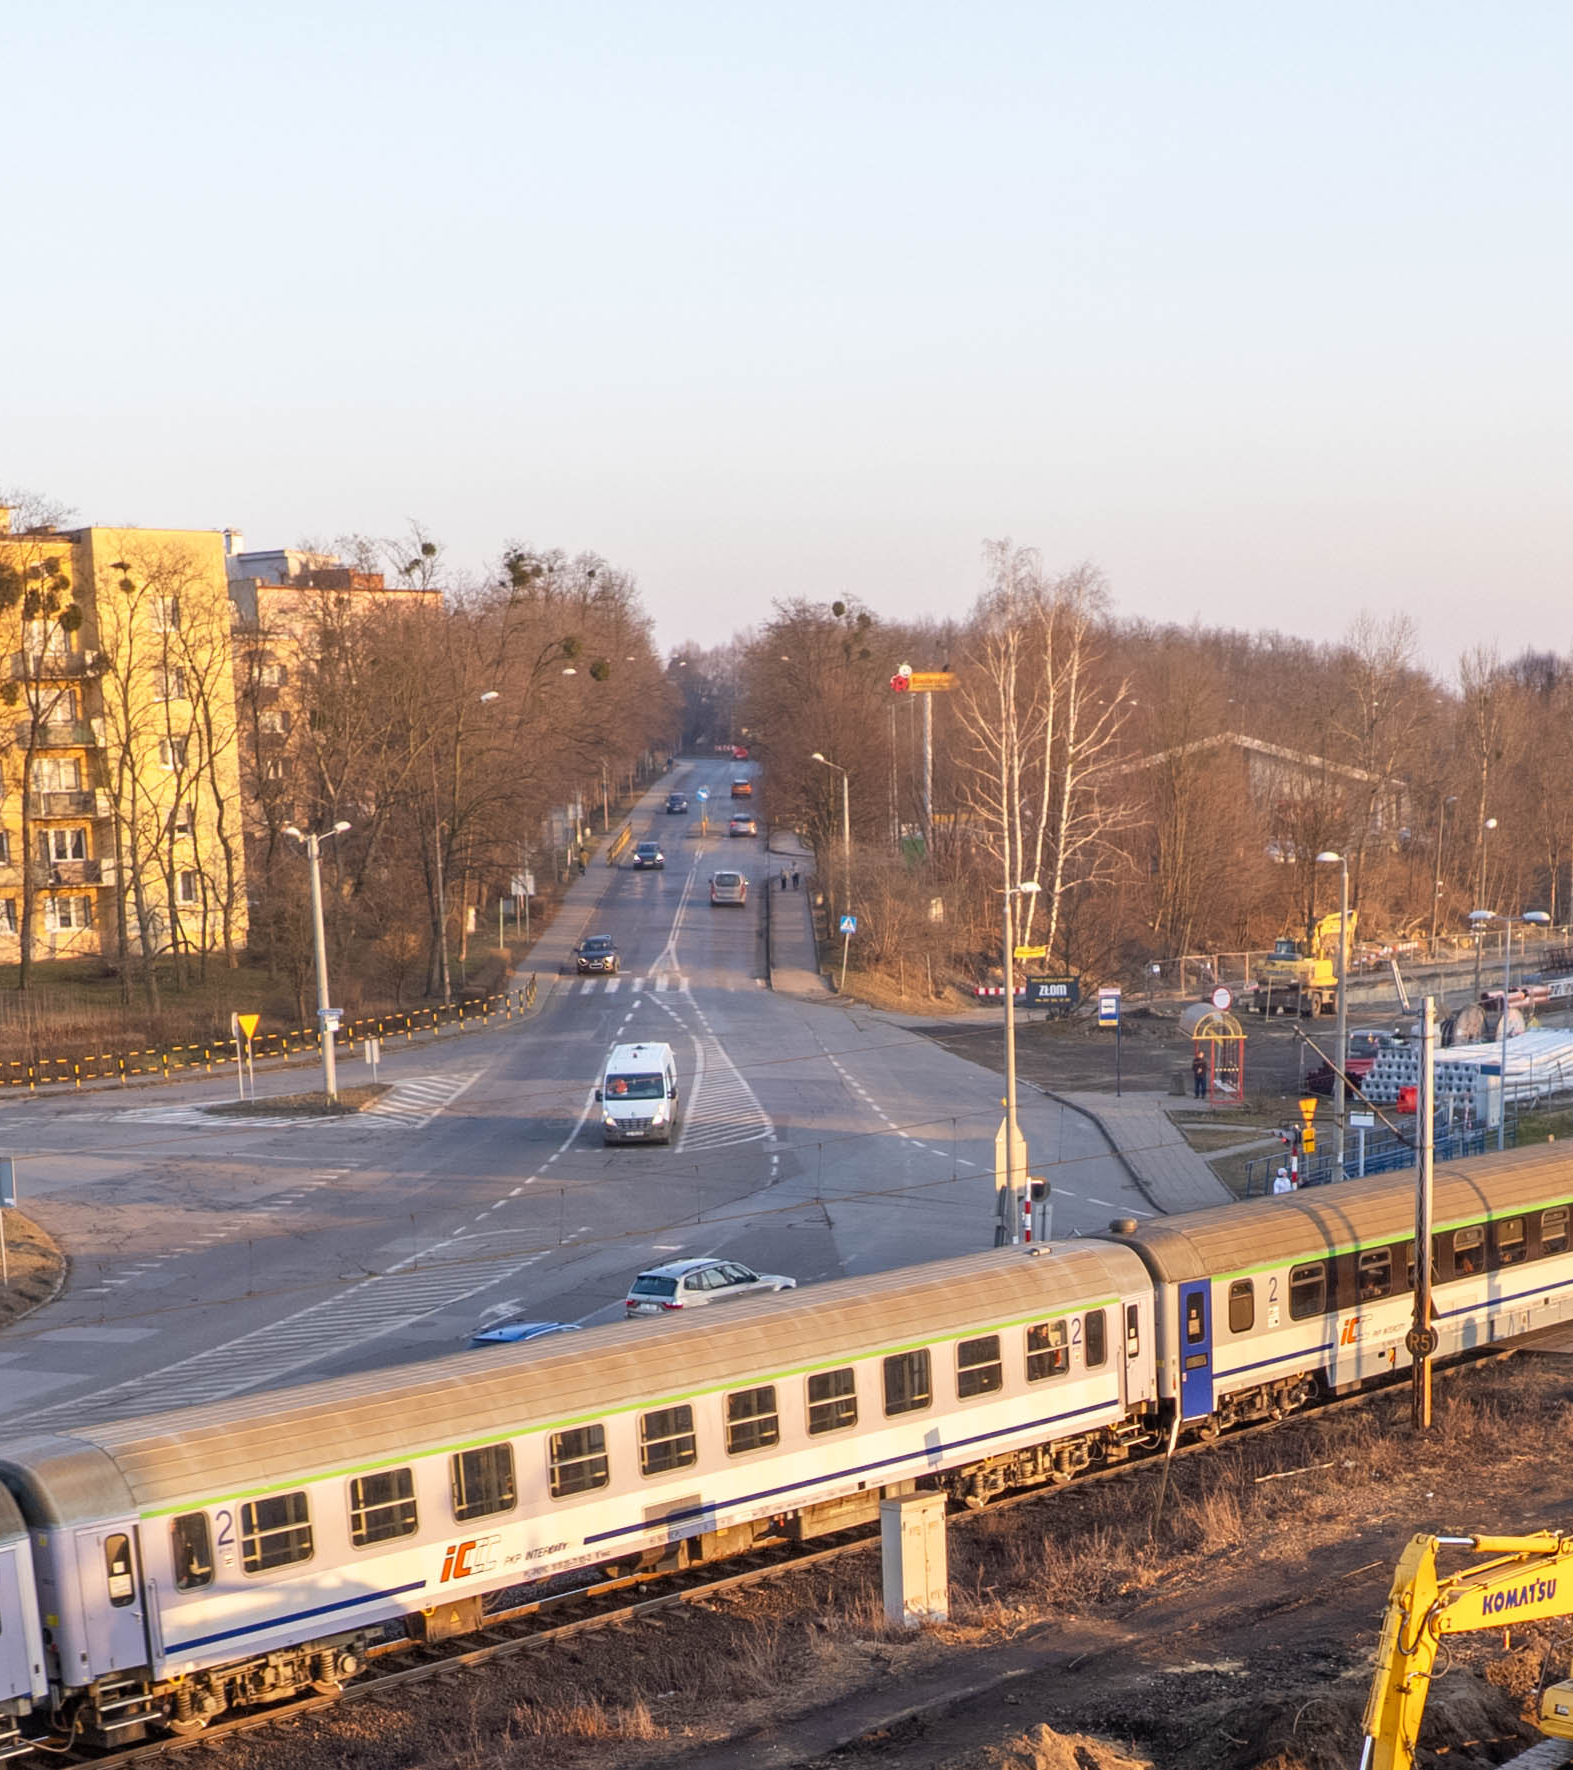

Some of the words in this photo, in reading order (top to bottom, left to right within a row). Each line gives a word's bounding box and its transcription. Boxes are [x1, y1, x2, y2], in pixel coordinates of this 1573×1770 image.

[1039, 984, 1067, 997] ZŁOM
[1268, 1276, 1278, 1303] 2
[1071, 1318, 1082, 1346] 2
[1409, 1332, 1430, 1351] R5
[215, 1509, 235, 1546] 2
[1482, 1578, 1557, 1616] KOMATSU
